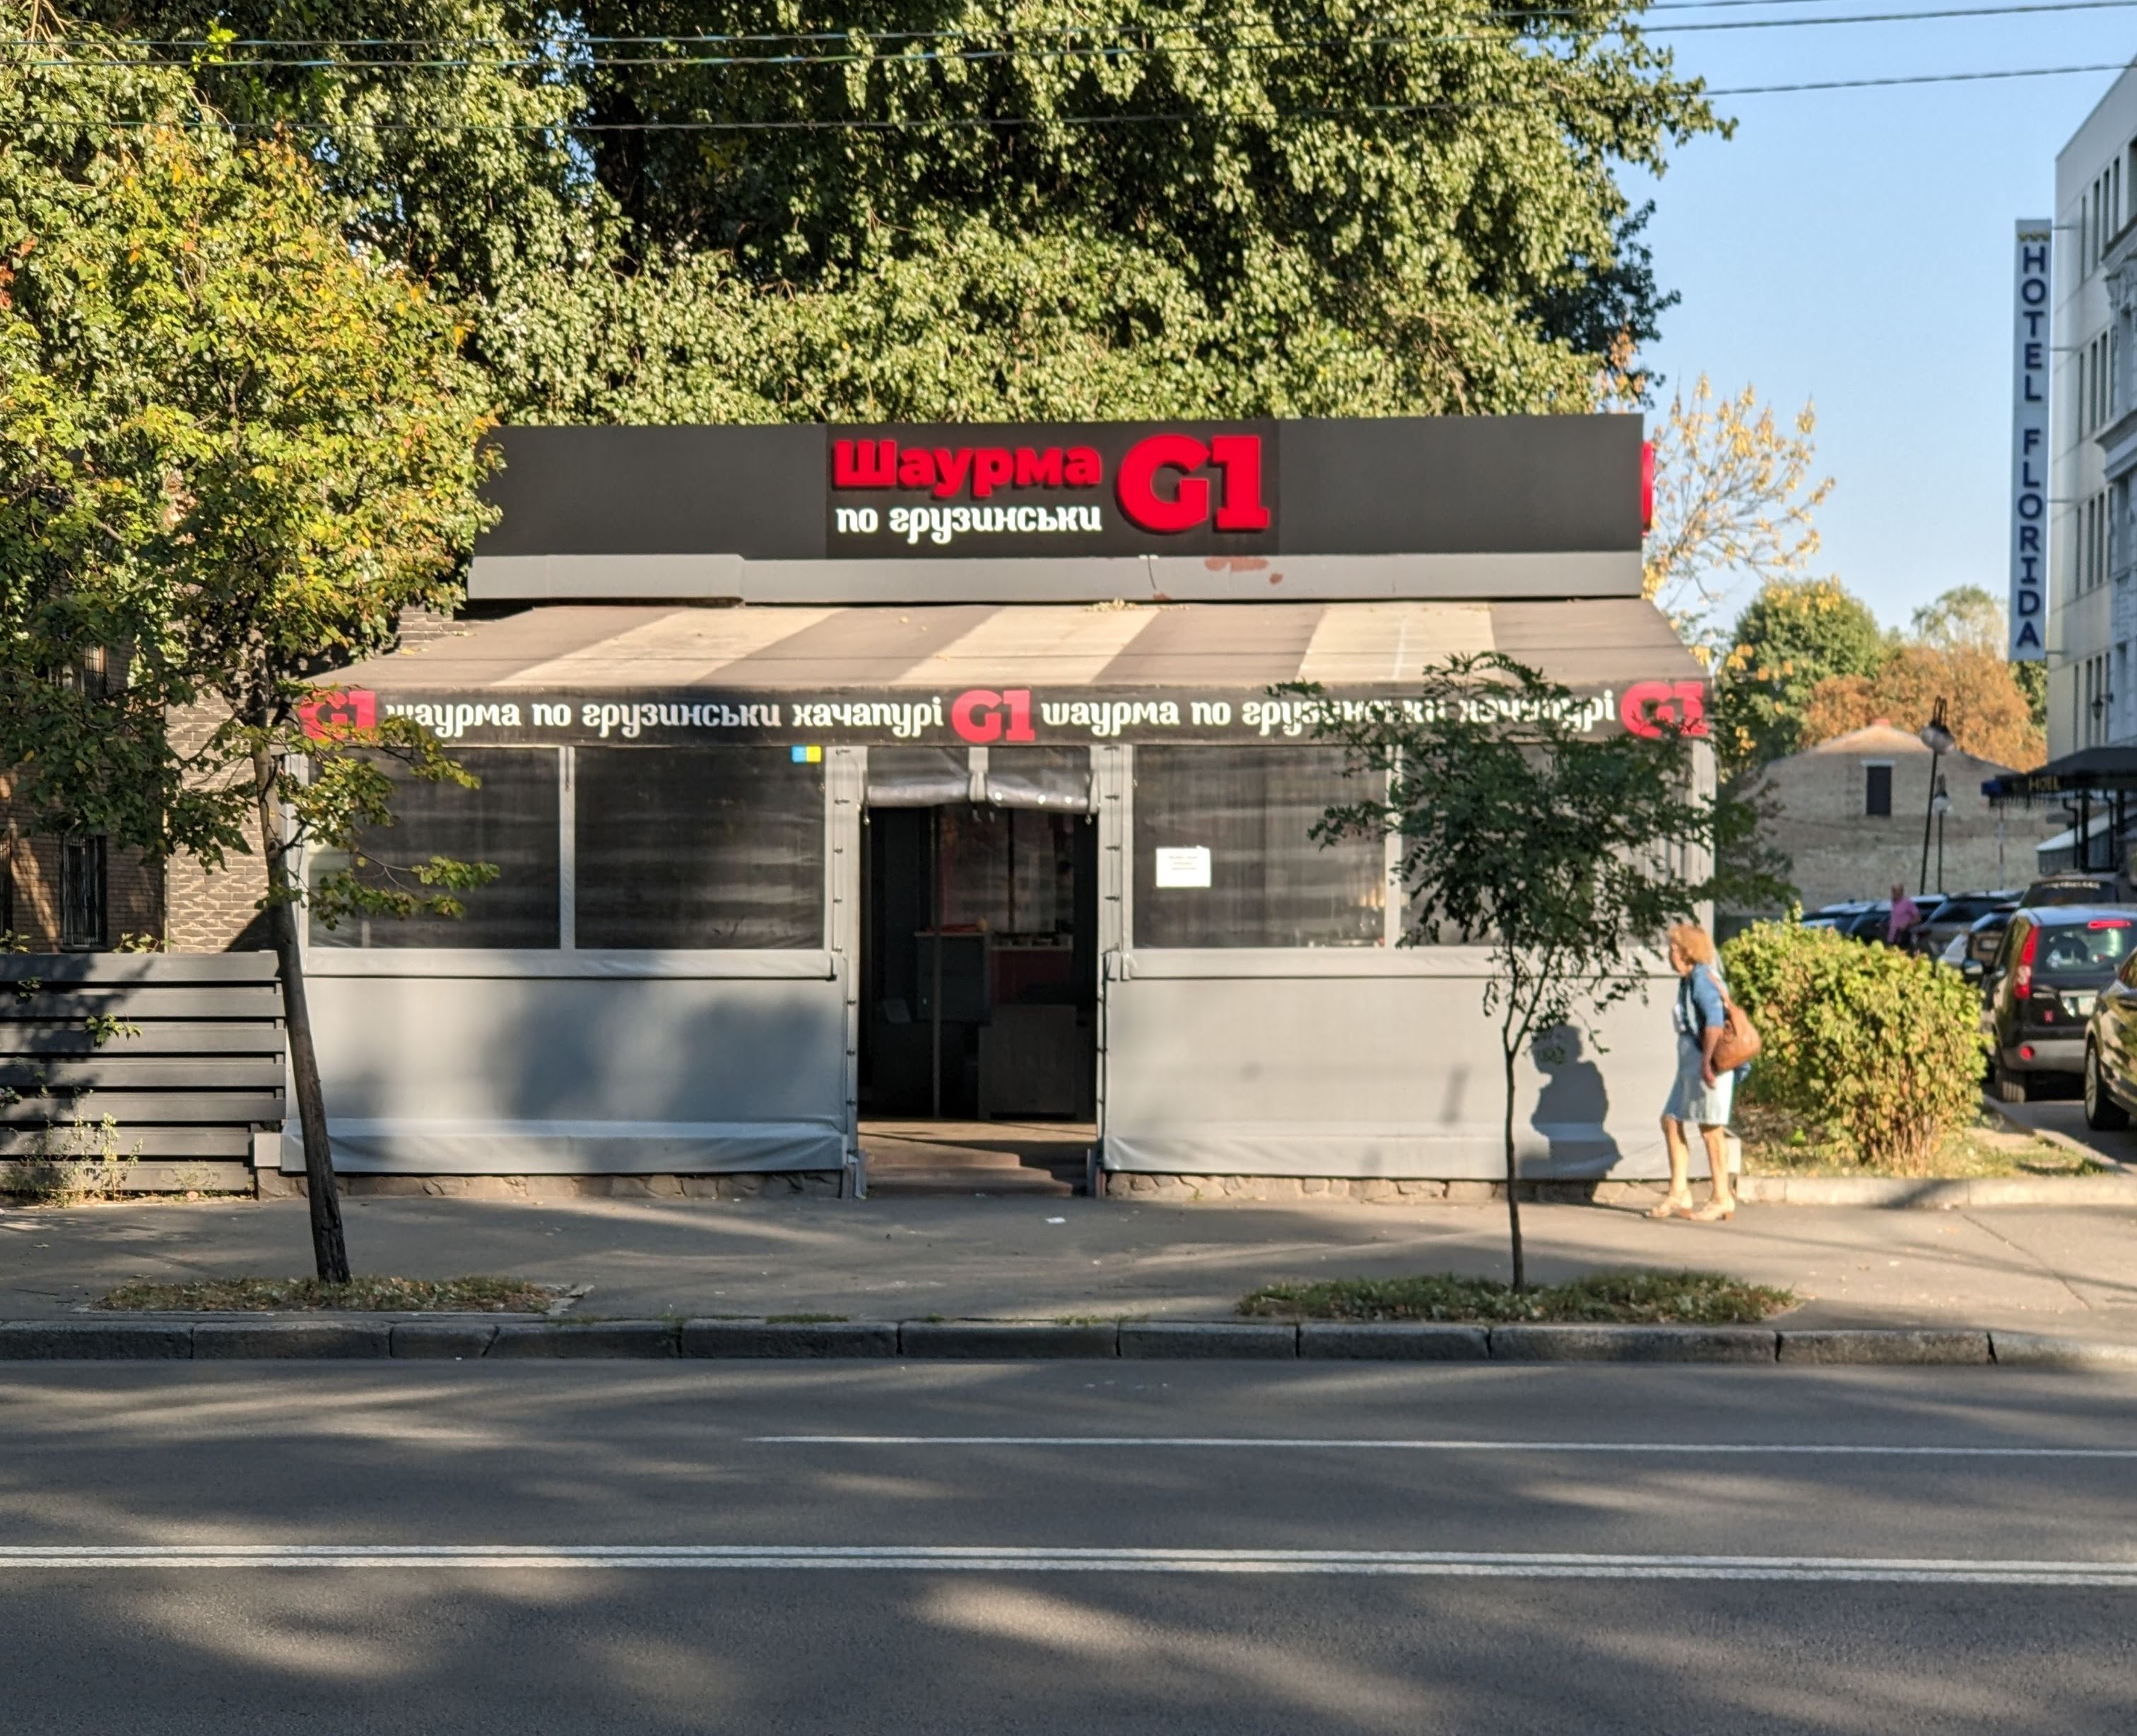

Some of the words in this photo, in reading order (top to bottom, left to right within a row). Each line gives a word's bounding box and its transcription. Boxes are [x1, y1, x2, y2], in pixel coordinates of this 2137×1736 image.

[2021, 245, 2047, 402] HOTEL
[834, 439, 1103, 498] Шаурма
[1117, 433, 1271, 531] G1
[835, 508, 878, 533] по
[889, 506, 1102, 544] грузинськи
[2015, 427, 2043, 649] FLORIDA
[297, 690, 375, 740] G1
[385, 703, 522, 738] шаурма
[531, 703, 572, 727] по
[582, 703, 782, 738] грузинськи
[791, 696, 944, 738] хачапурі
[950, 689, 1037, 743] G1
[1040, 700, 1181, 737] шаурма
[1190, 701, 1232, 725] по
[1620, 680, 1709, 738] G1
